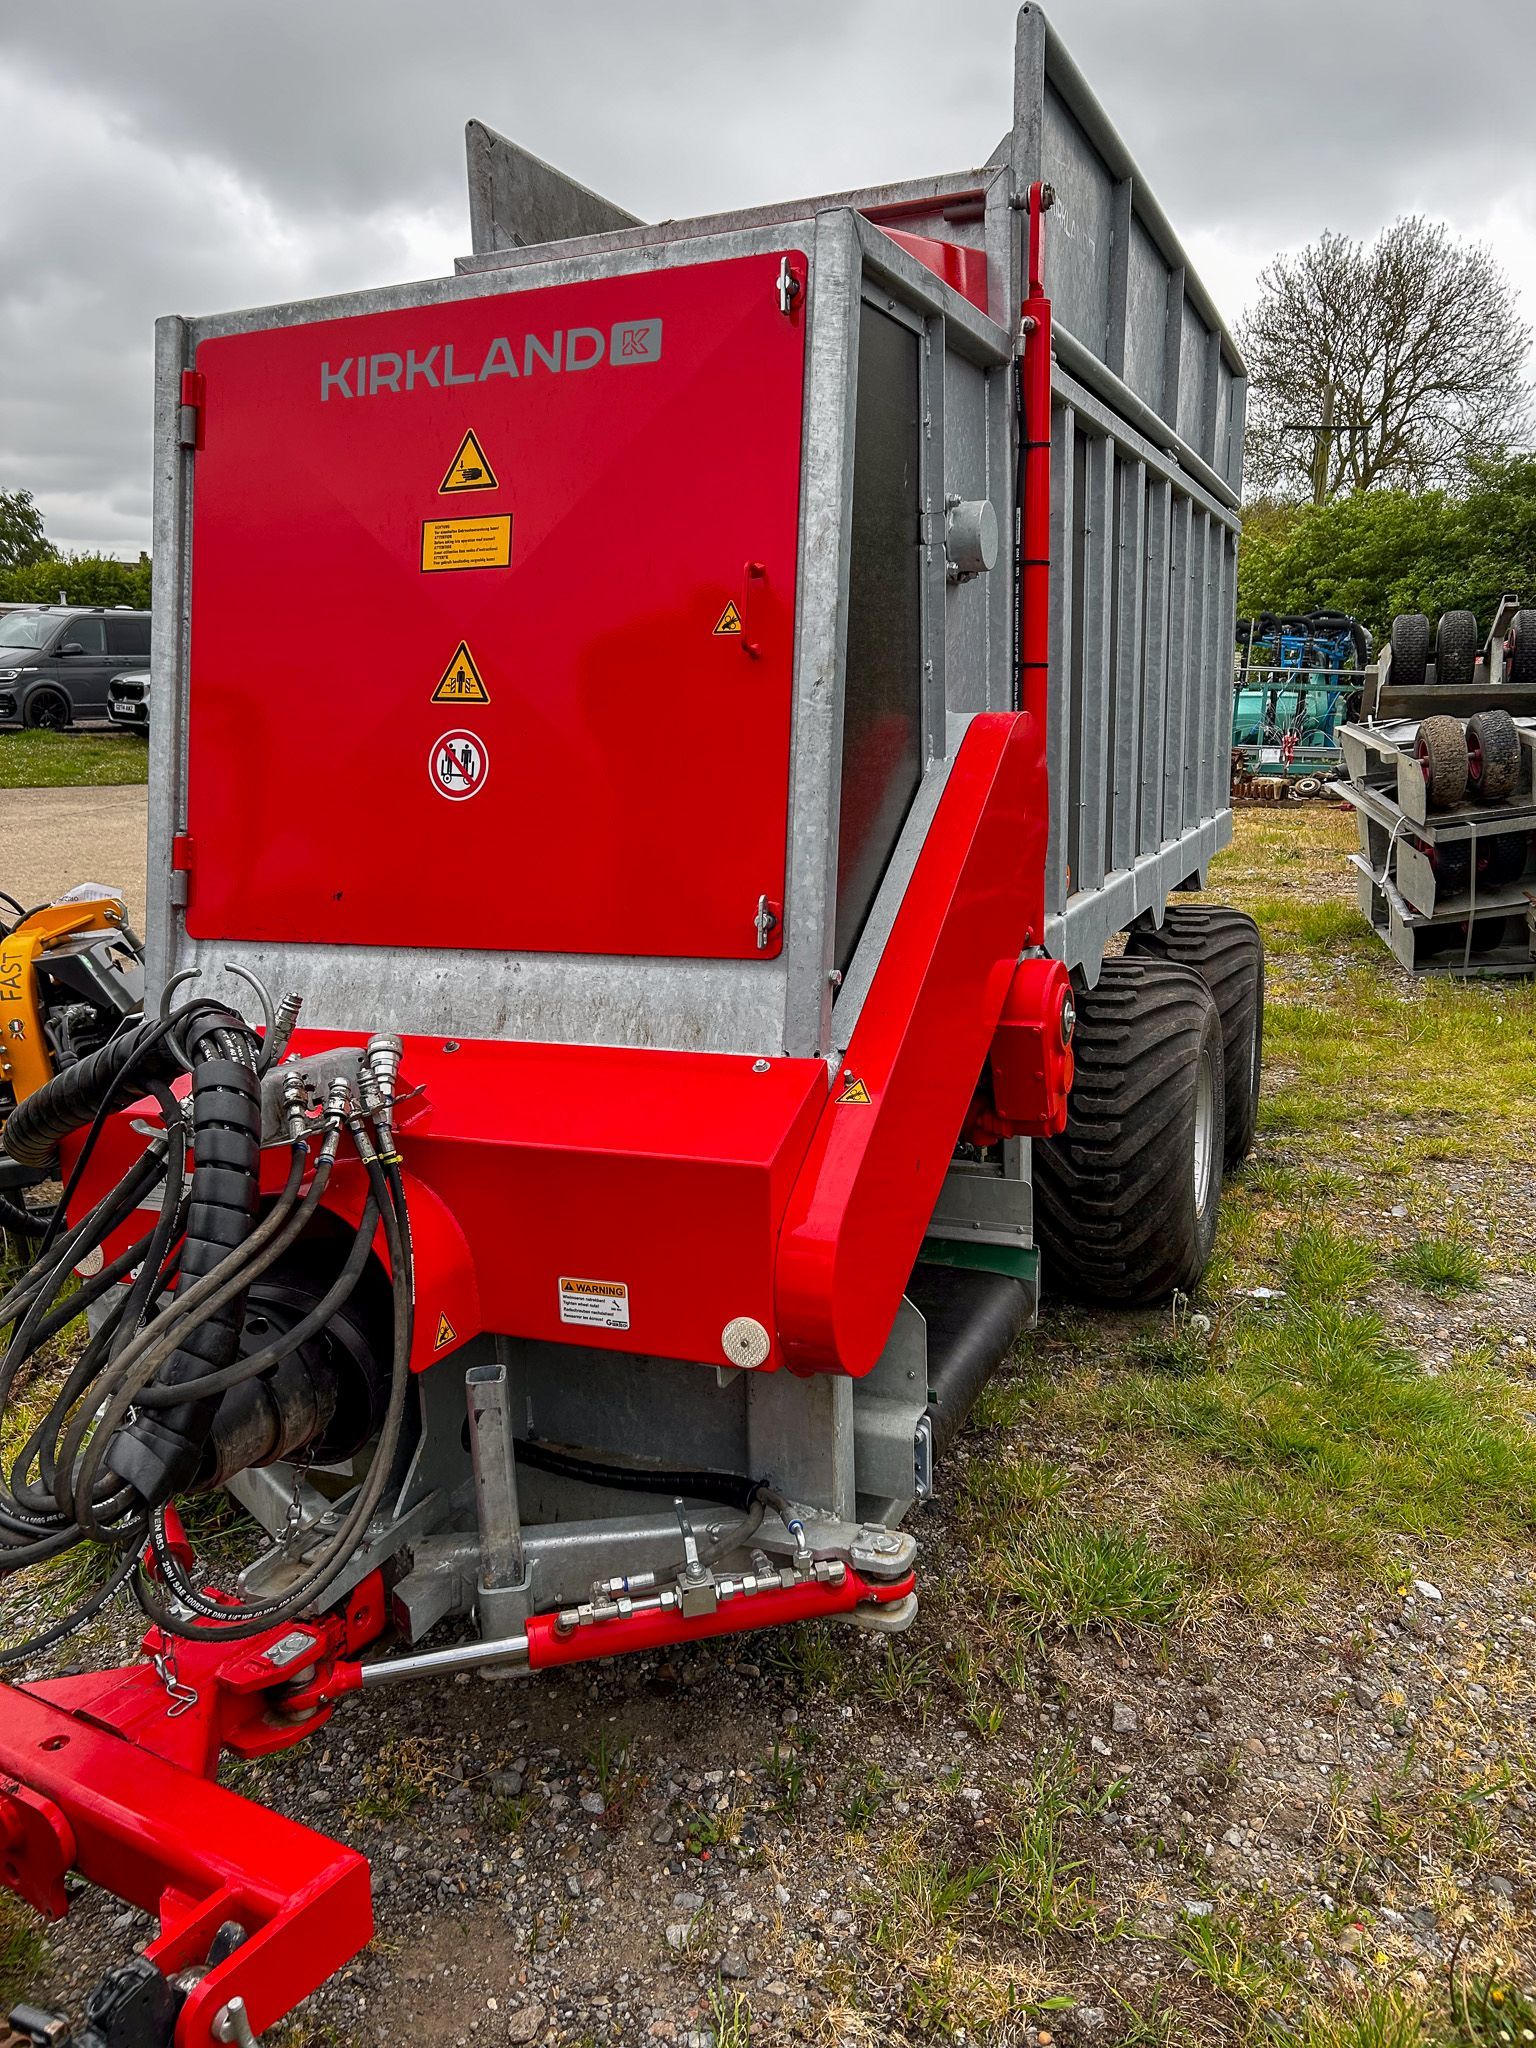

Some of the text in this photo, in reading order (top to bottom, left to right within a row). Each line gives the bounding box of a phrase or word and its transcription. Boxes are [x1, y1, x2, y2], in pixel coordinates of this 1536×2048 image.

[320, 327, 606, 402] KIRKLAND
[0, 952, 23, 1002] FAST
[576, 1283, 623, 1296] WARNING
[154, 1518, 162, 1532] EN
[155, 1532, 165, 1551] 853
[161, 1560, 175, 1578] 2SN
[172, 1580, 187, 1598] SAE
[183, 1594, 213, 1617] 100R2AT
